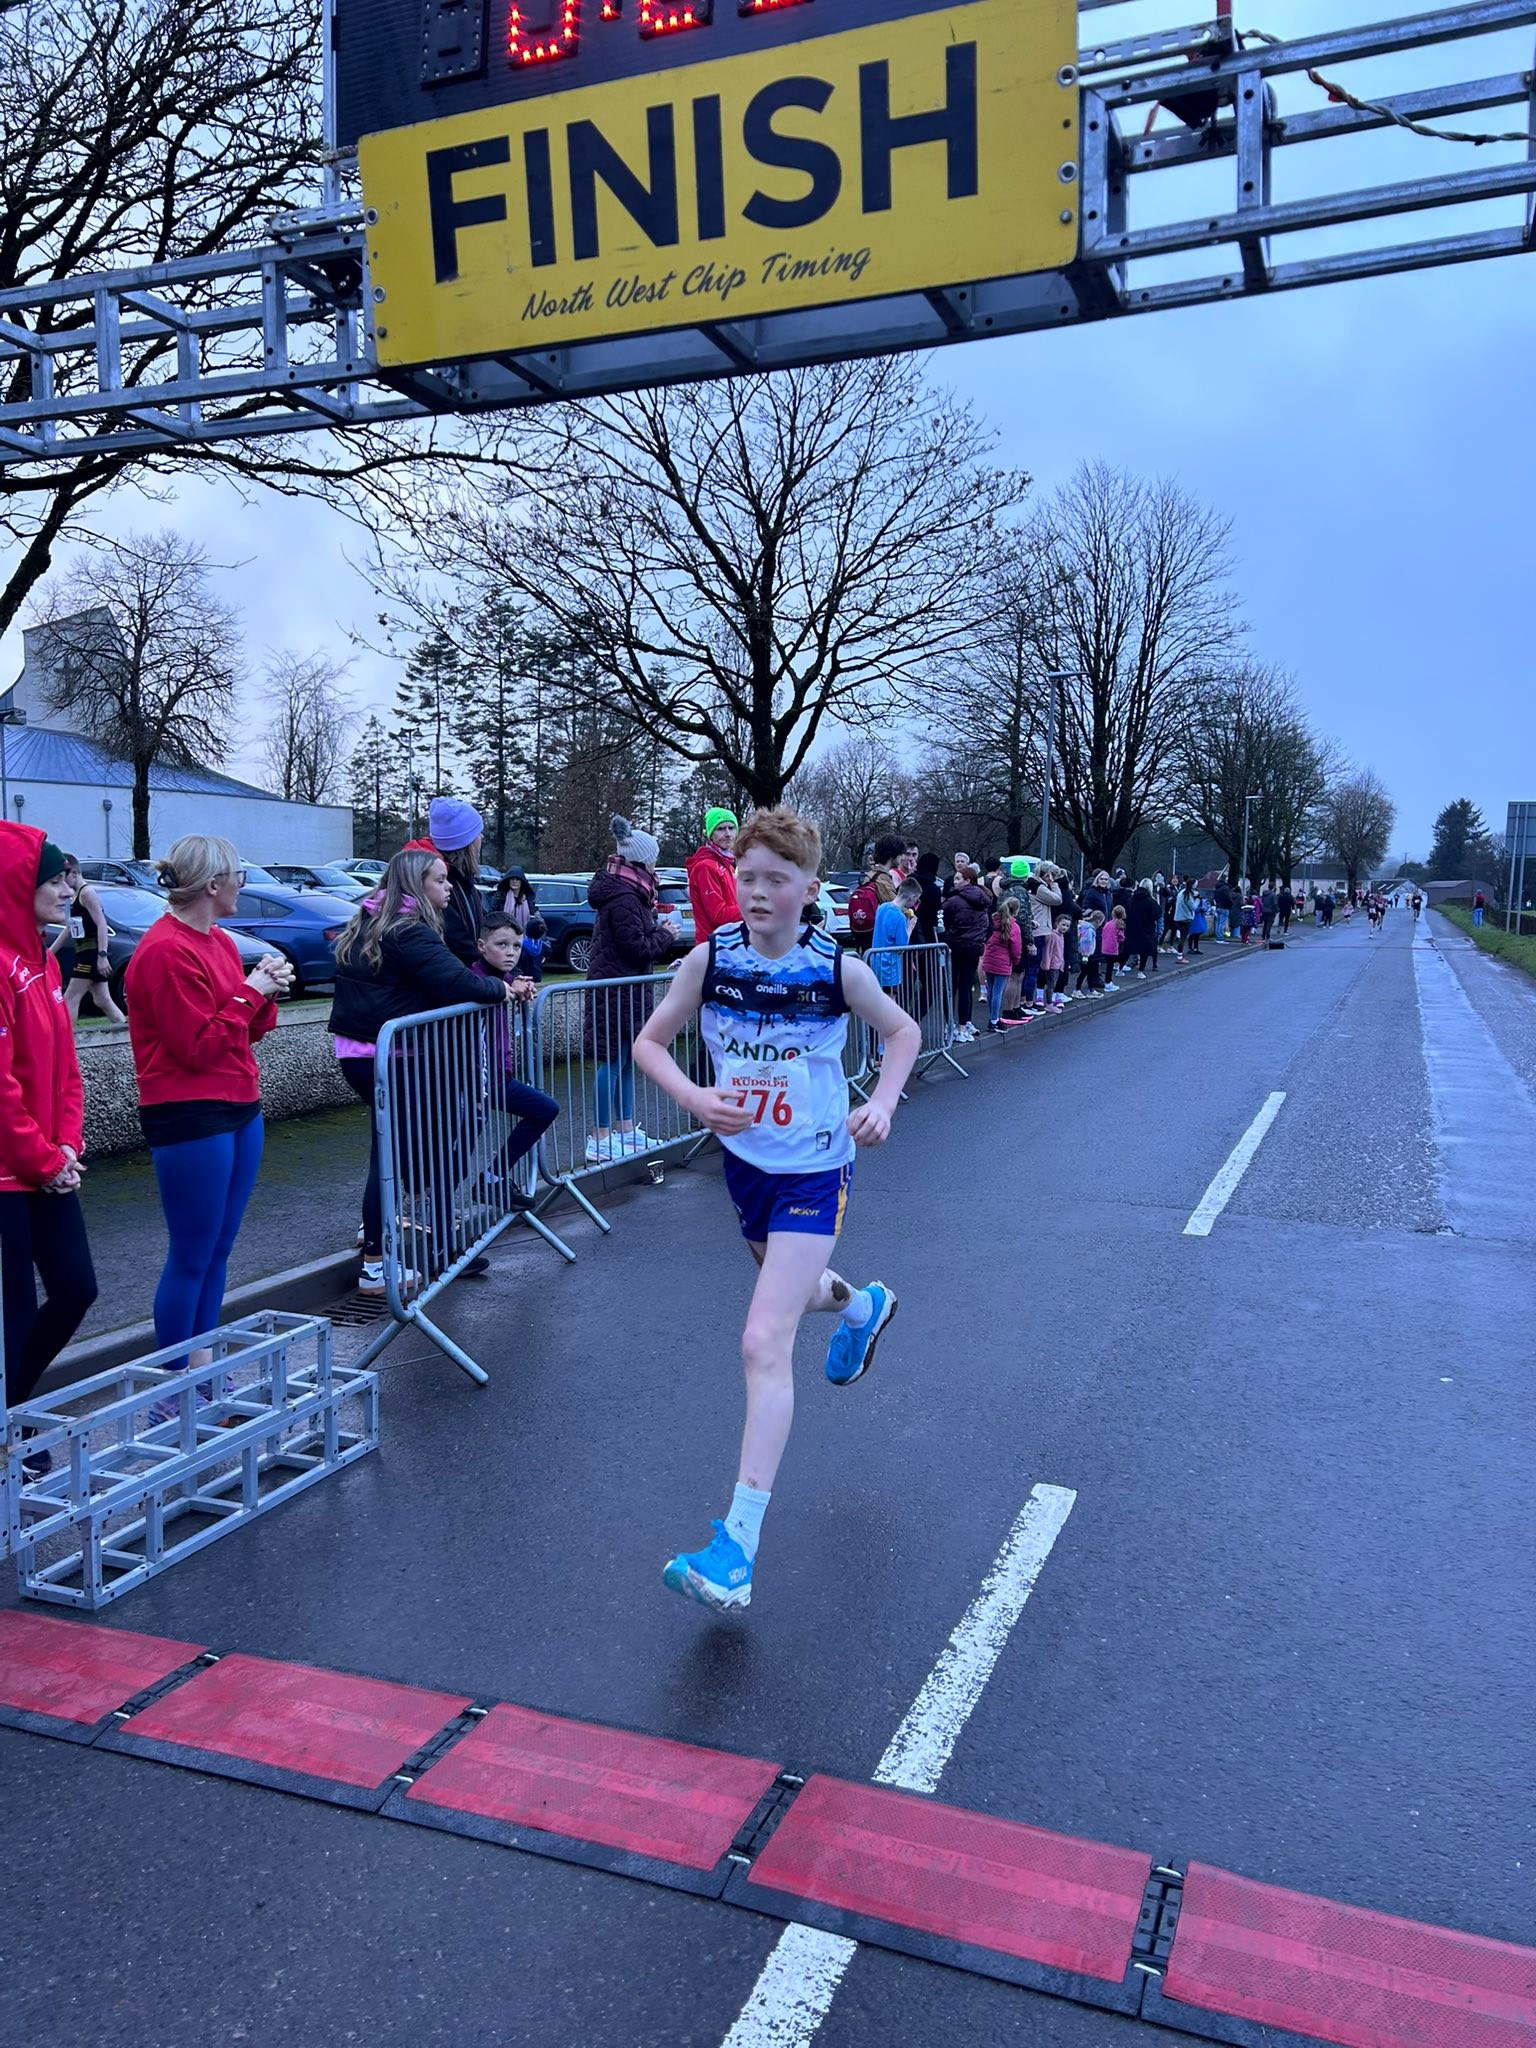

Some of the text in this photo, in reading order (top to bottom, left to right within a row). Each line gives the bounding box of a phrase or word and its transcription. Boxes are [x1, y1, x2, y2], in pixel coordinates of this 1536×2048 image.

[426, 40, 979, 284] FINISH
[521, 247, 872, 321] North West Chip Timing
[732, 1077, 788, 1088] RUDOLPH
